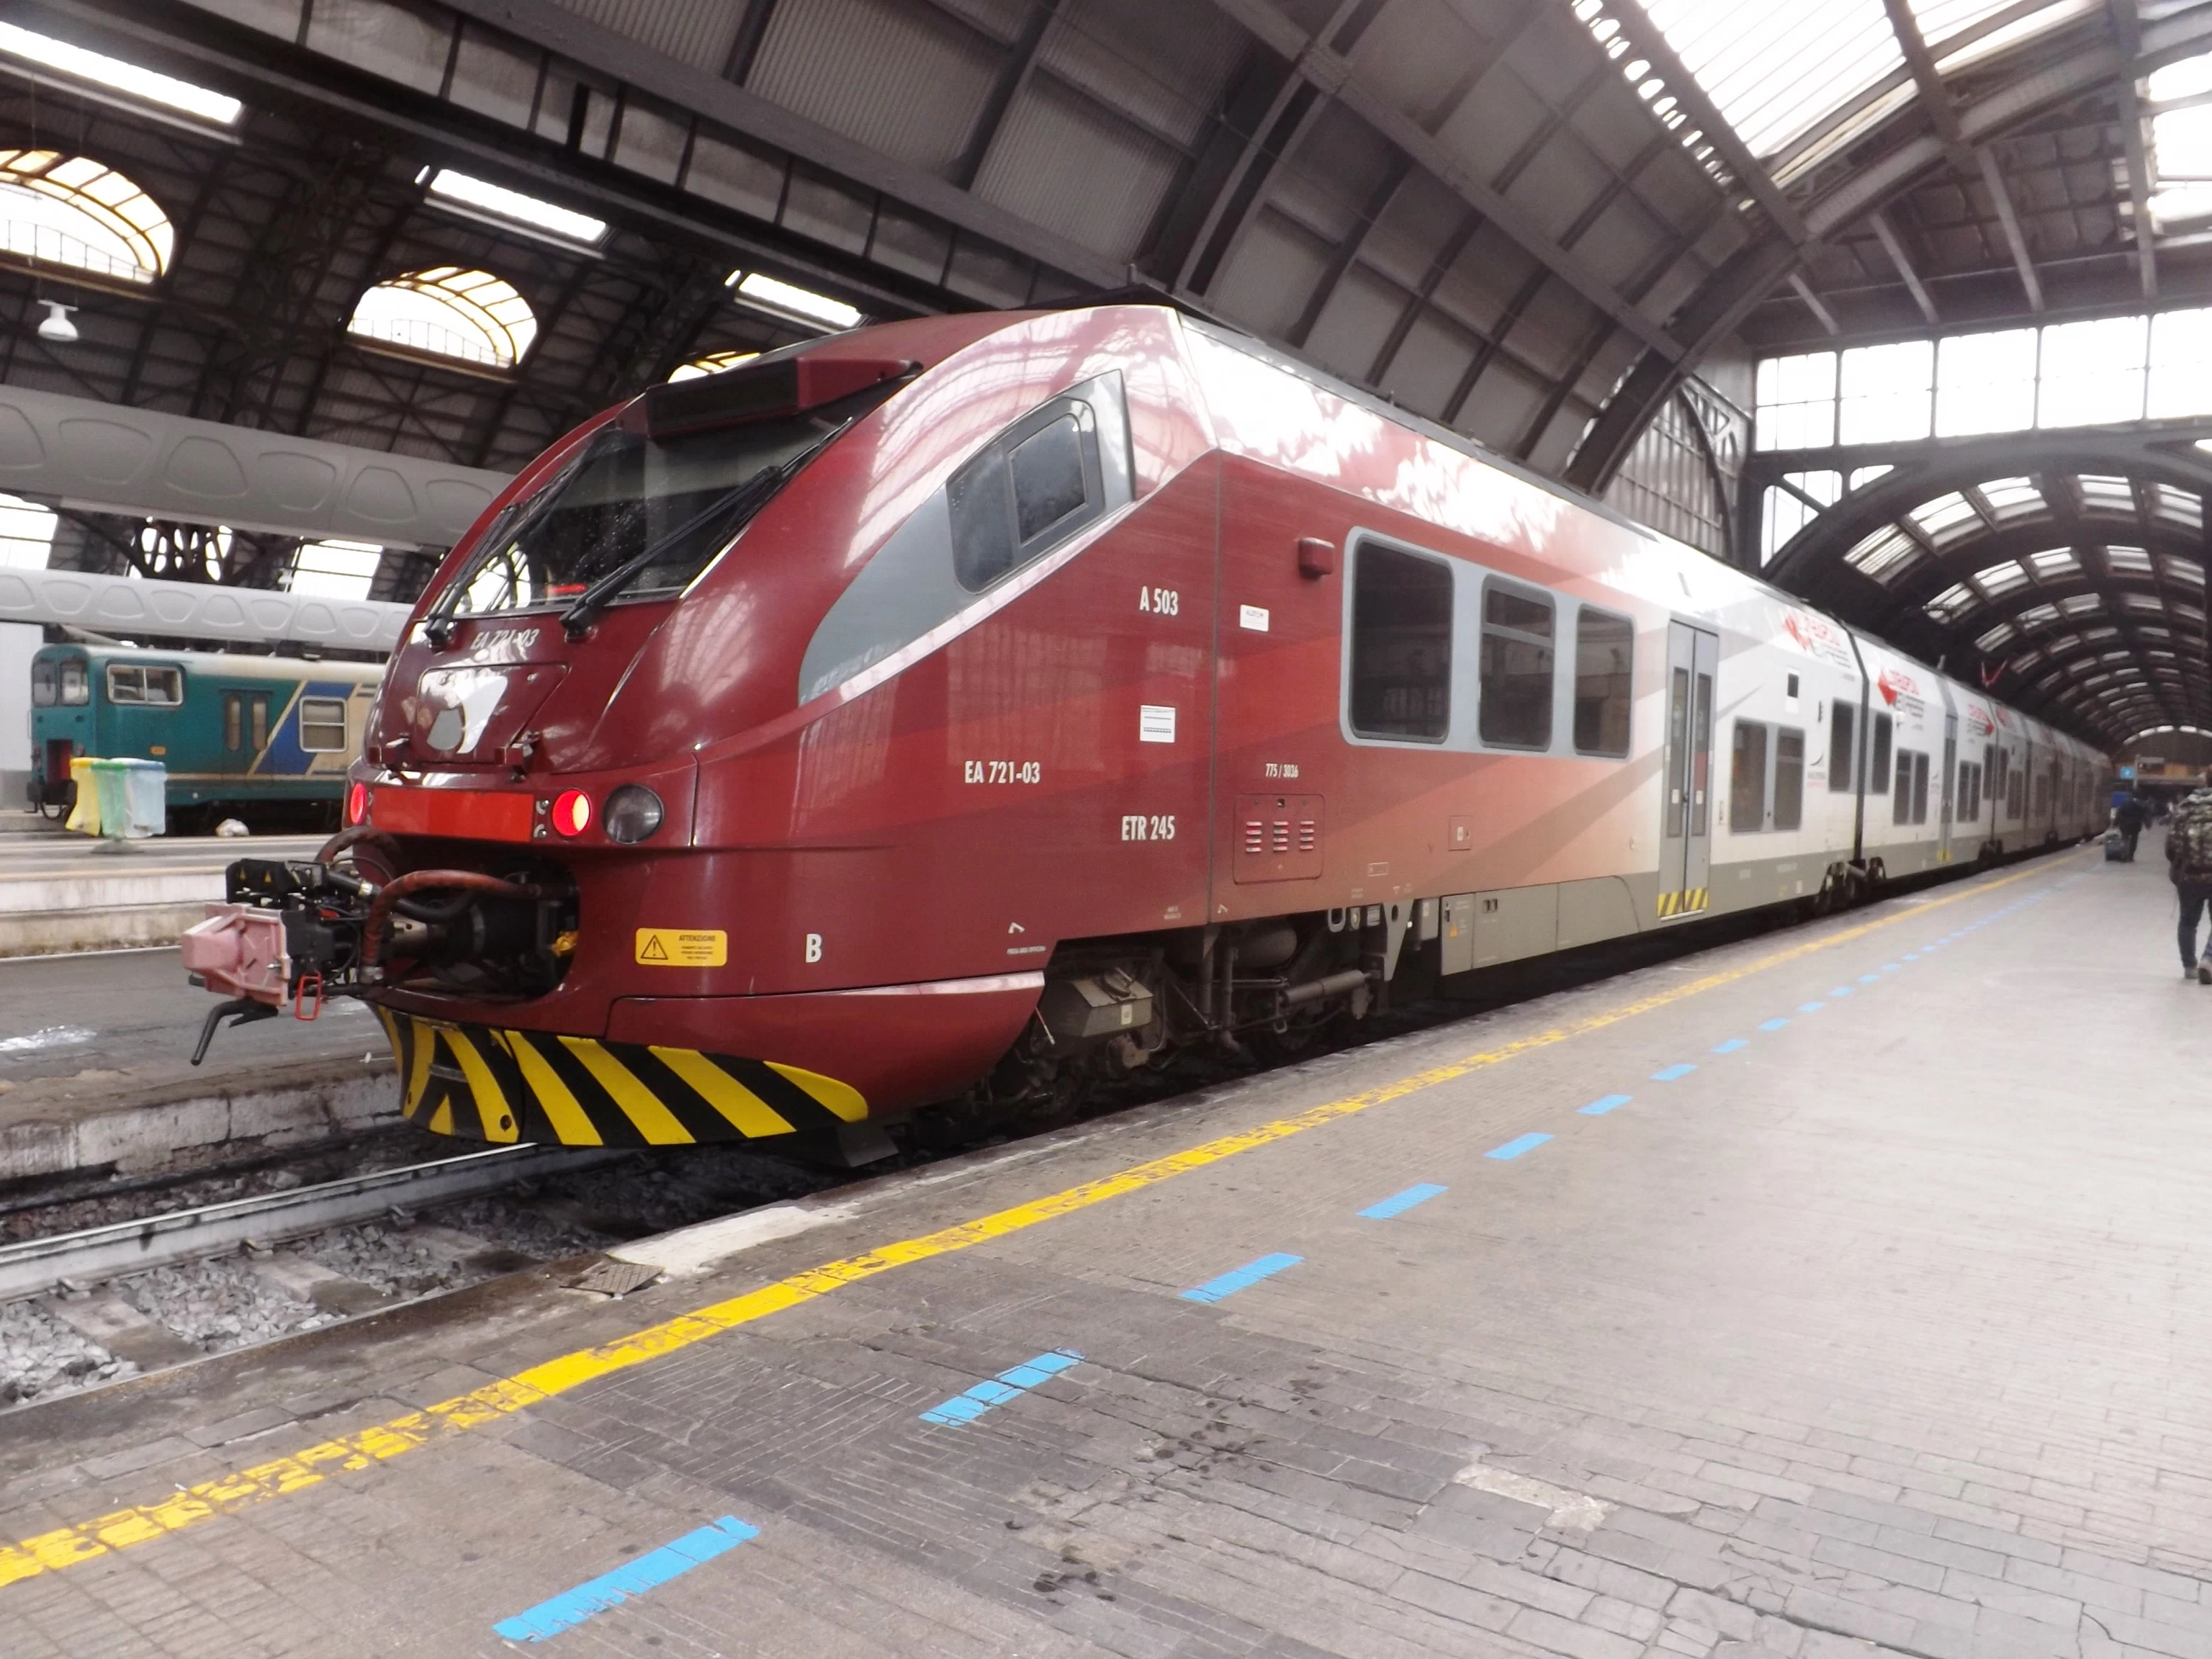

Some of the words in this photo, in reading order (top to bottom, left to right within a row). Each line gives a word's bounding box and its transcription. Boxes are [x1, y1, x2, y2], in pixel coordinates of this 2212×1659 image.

[1139, 585, 1150, 611] A
[1153, 588, 1178, 616] 503
[470, 631, 490, 649] EA
[487, 629, 540, 649] 721-03
[965, 760, 984, 783] EA
[988, 761, 1040, 783] 721-03
[1122, 815, 1146, 840] ETR
[1150, 815, 1175, 840] 245
[805, 933, 822, 963] B
